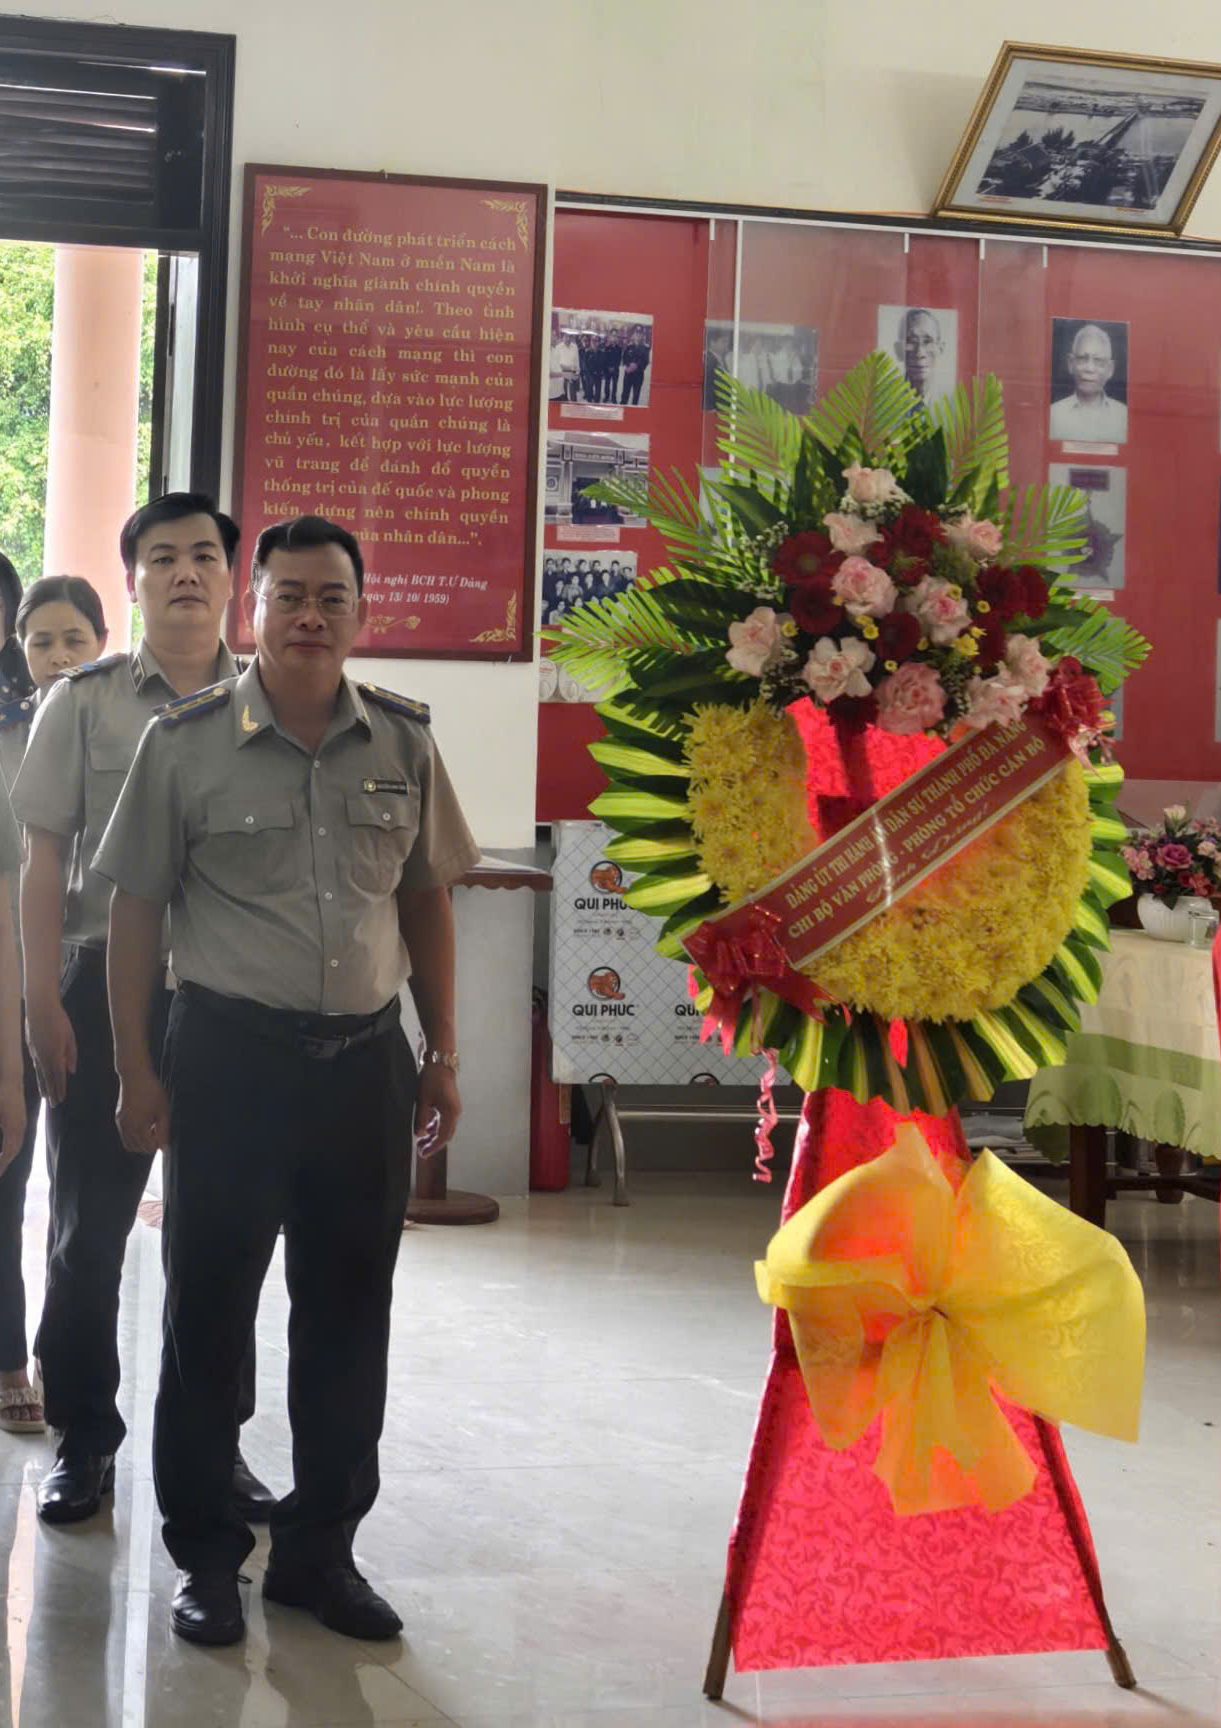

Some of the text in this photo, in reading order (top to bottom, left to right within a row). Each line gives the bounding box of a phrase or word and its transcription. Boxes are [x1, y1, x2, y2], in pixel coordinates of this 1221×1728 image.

[307, 226, 338, 241] Con
[342, 228, 393, 247] đường
[397, 232, 433, 248] phát
[437, 232, 476, 248] triển
[480, 237, 516, 251] cách
[269, 250, 515, 273] mạng Việt Nam ở miền Nam là
[269, 271, 515, 298] khởi nghĩa giành chính quyền
[269, 293, 287, 308] về
[299, 297, 323, 312] tay
[333, 297, 374, 312] nhân
[434, 302, 473, 317] Theo
[268, 317, 515, 342] hình cụ thể và yêu cầu hiện
[268, 340, 514, 364] nay của cách mạng thì con
[267, 363, 514, 389] đường đó là lấy sức mạnh của
[266, 385, 514, 413] quần chúng, dựa vào lực lượng
[265, 409, 511, 434] chính trị của quần chúng là
[265, 431, 292, 445] chủ
[340, 434, 365, 448] kết
[371, 435, 402, 453] hợp
[407, 438, 432, 452] với
[437, 439, 461, 456] lực
[466, 440, 512, 459] lượng
[264, 456, 510, 480] vũ trang để đánh đổ quyền
[264, 477, 510, 504] thống trị của đế quốc và phong
[314, 503, 356, 520] dựng
[364, 506, 395, 519] nên
[404, 506, 450, 522] chính
[459, 509, 509, 526] quyền
[383, 529, 424, 544] nhân
[411, 574, 436, 586] BCH
[788, 915, 815, 938] CHI
[812, 898, 834, 922] BỘ
[902, 813, 947, 853] PHÒNG
[1024, 735, 1046, 757] BỘ
[574, 898, 599, 910] QUI
[572, 1004, 597, 1016] QUI
